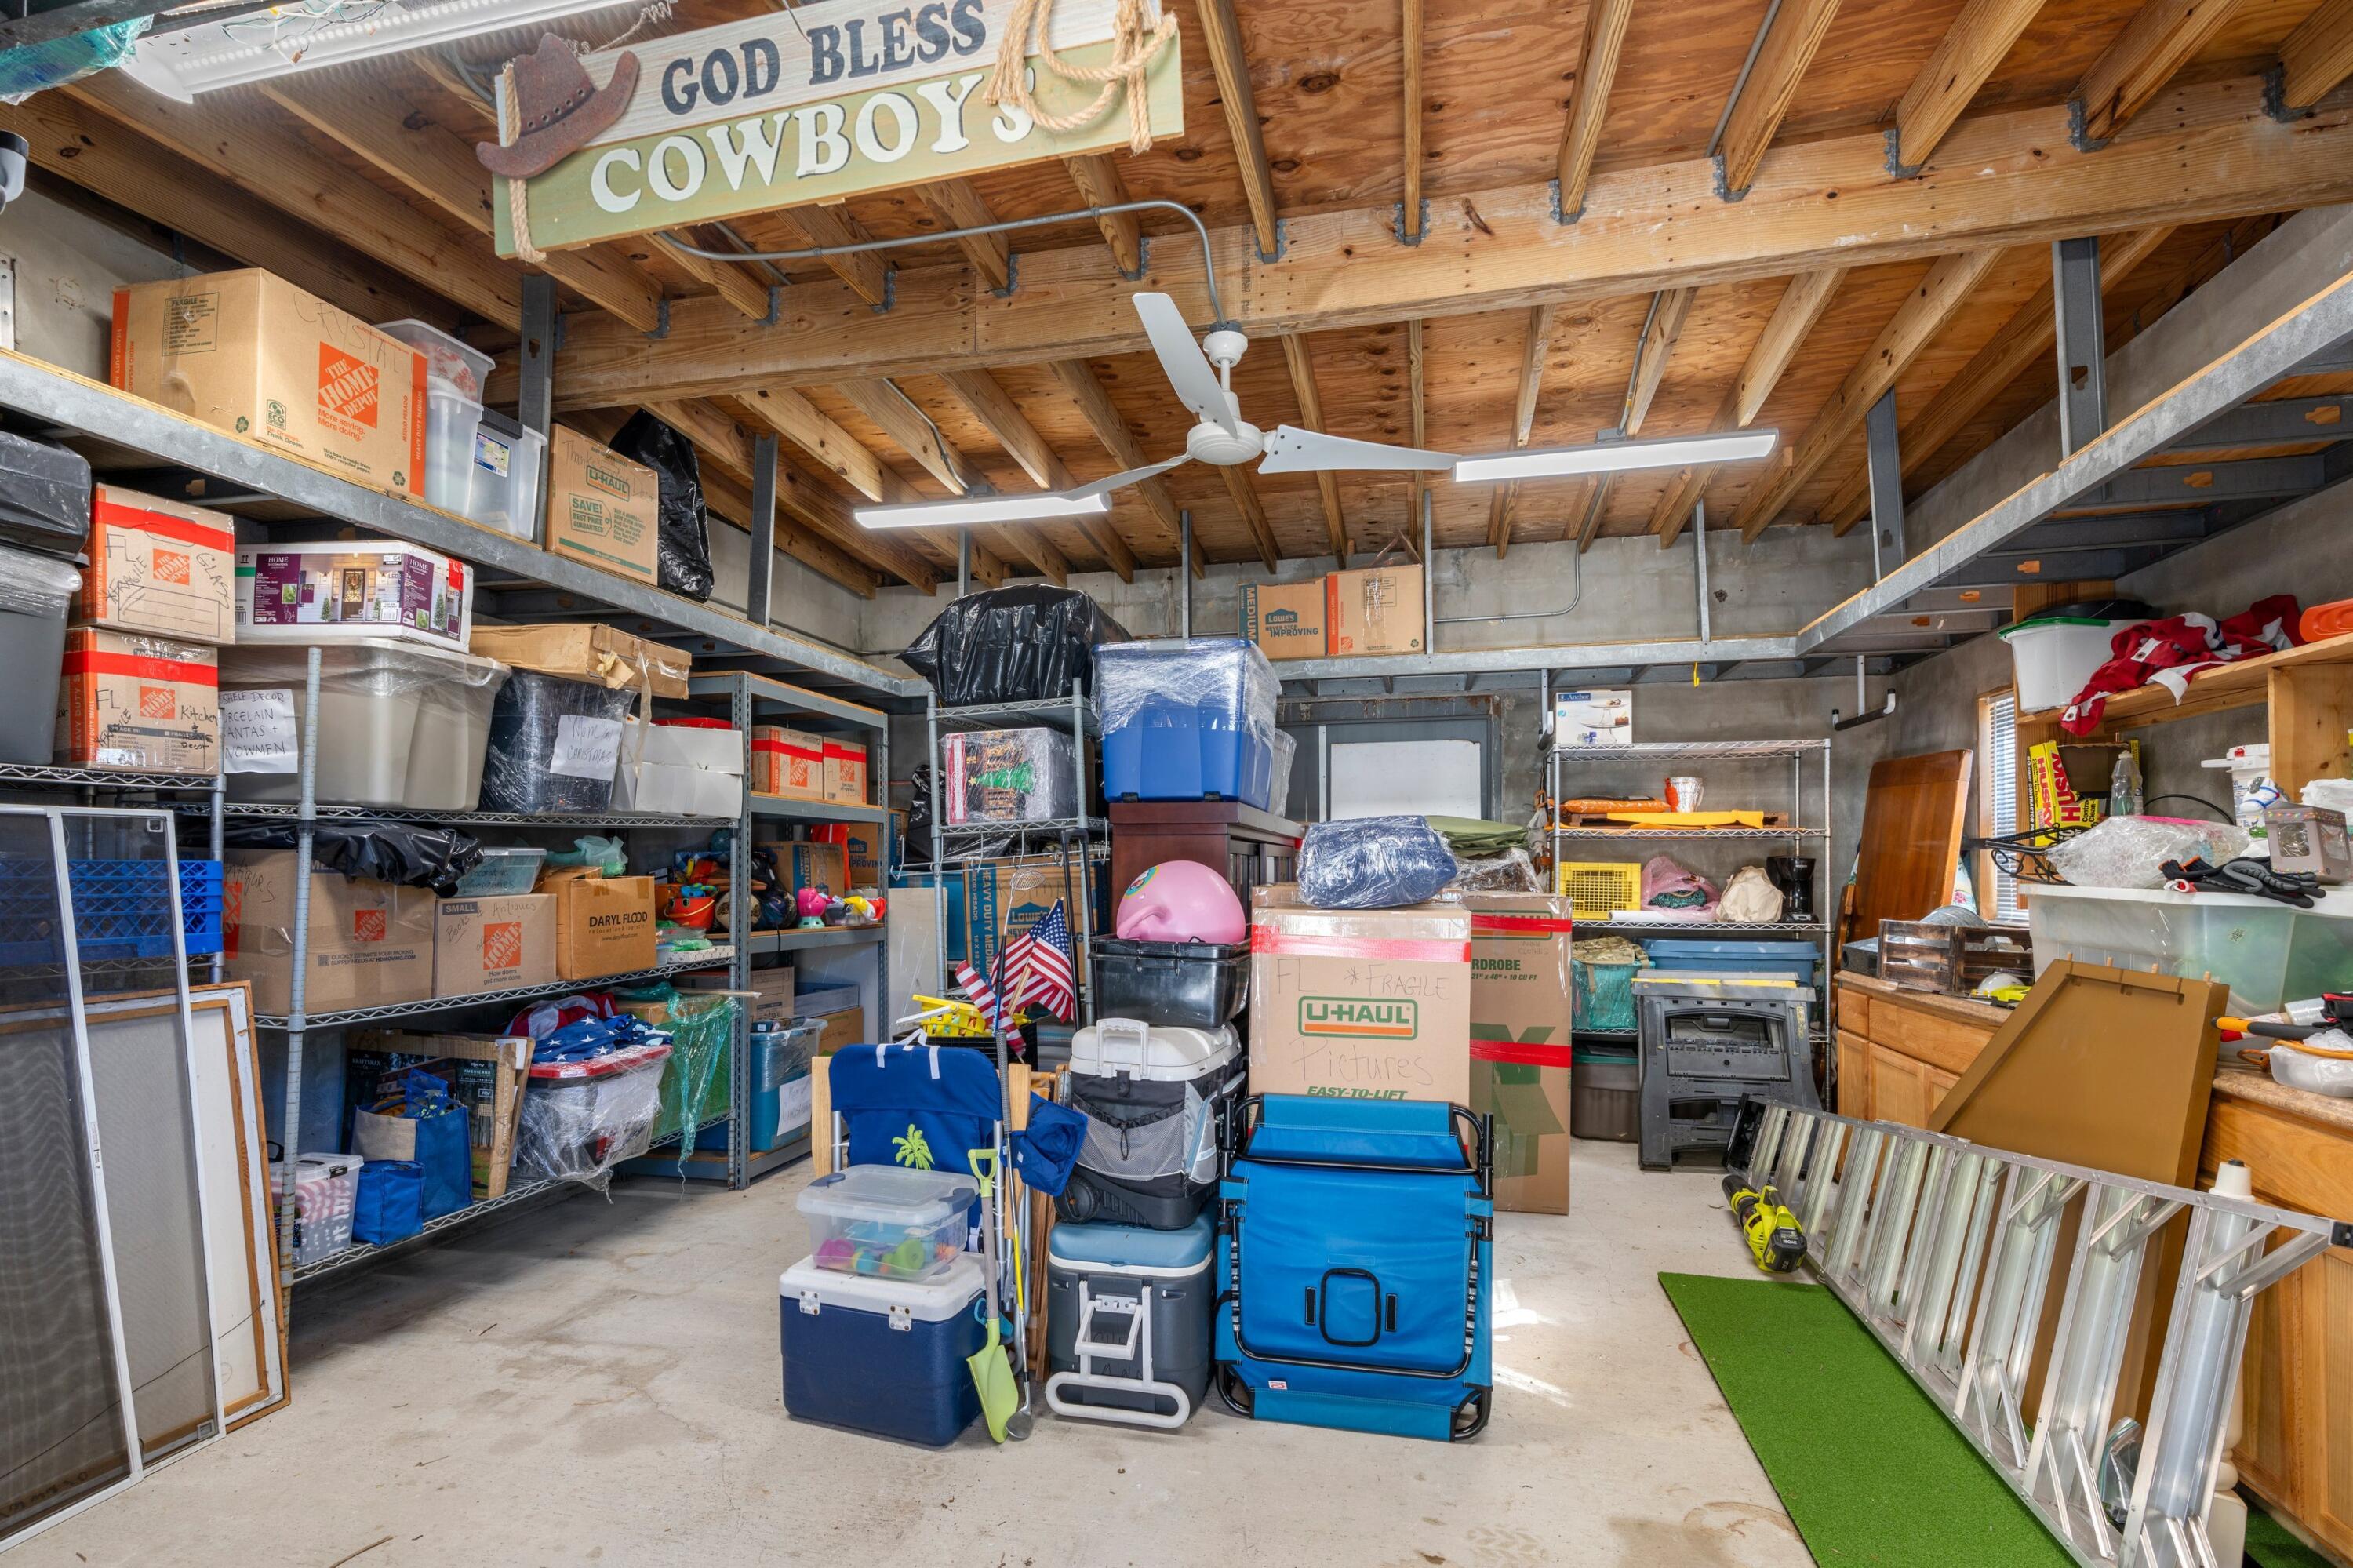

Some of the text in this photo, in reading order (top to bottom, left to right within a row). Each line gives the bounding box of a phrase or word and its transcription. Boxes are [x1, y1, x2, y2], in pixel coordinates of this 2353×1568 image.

[661, 0, 987, 115] GOD BLESS
[325, 358, 352, 380] THE
[318, 363, 379, 410] HOME
[341, 389, 379, 417] DEPOT
[267, 413, 285, 424] ECO
[317, 408, 365, 435] More saving.
[317, 417, 362, 442] More doing.
[266, 430, 304, 449] Think Green.
[589, 469, 628, 494] U-HAUL
[572, 497, 602, 515] SAVE!
[573, 512, 603, 526] BEST PRICE
[573, 521, 603, 533] GUARANTEED
[105, 533, 136, 563] FL
[154, 555, 191, 580] HOME
[157, 553, 171, 566] THE
[410, 558, 428, 571] HOME
[167, 568, 191, 583] DEPOT
[1246, 587, 1257, 640] MEDIUM
[1270, 627, 1318, 638] IMPROVING
[95, 688, 121, 711] FL
[140, 688, 176, 718] HOME
[144, 691, 158, 703] THE
[223, 692, 285, 705] SHELF DECOR
[154, 702, 176, 719] DEPOT
[180, 704, 219, 726] Kitchen
[224, 708, 274, 723] ORCELAIN
[227, 725, 265, 740] ANTAS
[225, 740, 285, 760] NOWMEN
[2037, 757, 2053, 828] HUSKY
[982, 869, 992, 902] HEAVY
[446, 904, 475, 913] SMALL
[493, 900, 536, 921] Antiques
[590, 911, 648, 927] DARYL FLOOD
[983, 904, 993, 930] DUTY
[354, 910, 385, 941] HOME
[446, 917, 470, 942] Books
[483, 922, 522, 969] HOME
[602, 933, 638, 941] www.darylflood.com
[498, 940, 522, 968] DEPOT
[1471, 959, 1521, 971] RDROBE
[1276, 958, 1318, 994] FL
[1307, 1002, 1410, 1024] U-HAUL
[1289, 1037, 1434, 1086] Pictures
[1307, 1086, 1409, 1101] EASY-TO-LIFT
